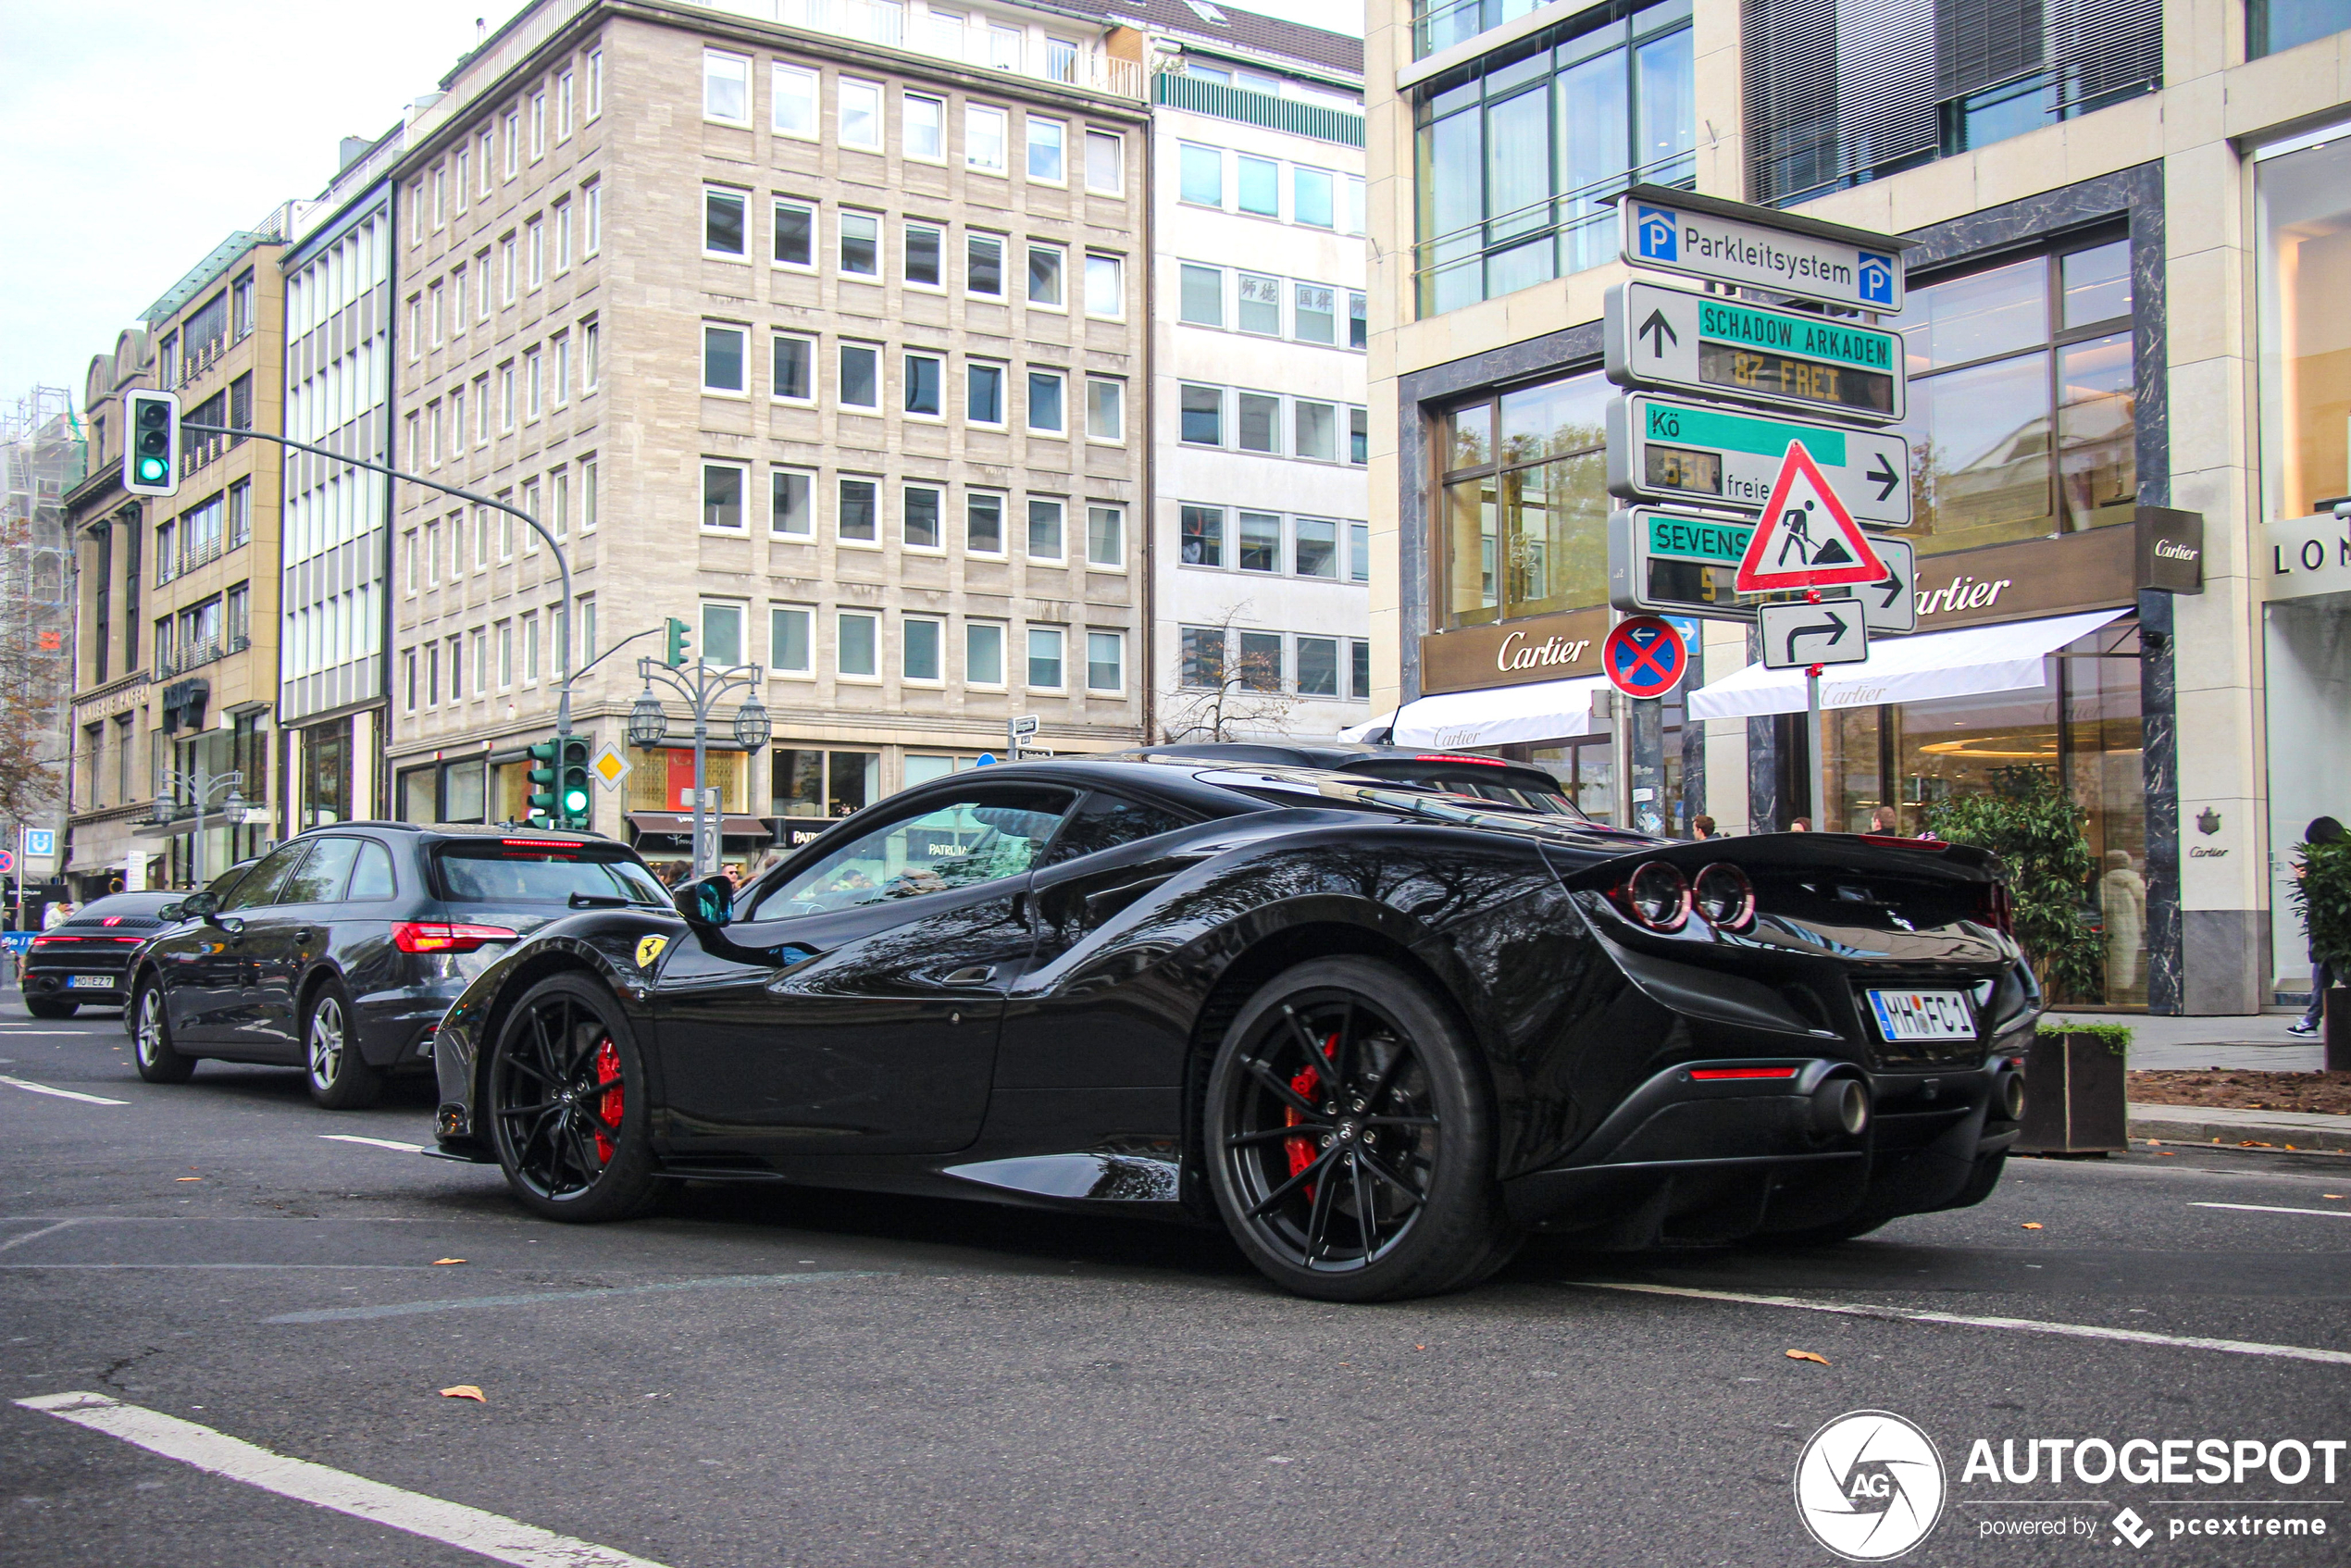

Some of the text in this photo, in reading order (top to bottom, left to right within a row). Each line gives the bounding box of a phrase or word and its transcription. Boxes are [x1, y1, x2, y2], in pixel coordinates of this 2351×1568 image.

[1686, 227, 1851, 285] Parkleitsystem
[1705, 306, 1886, 366] SCHADOW ARKADEN
[1735, 353, 1840, 402] 87 FREI
[1652, 410, 1680, 438] Kö
[1727, 474, 1770, 501] freie
[1655, 524, 1748, 557] SEVENS
[2154, 538, 2198, 561] Cartier
[1701, 567, 1717, 602] 5
[1914, 572, 2011, 616] artier
[1497, 630, 1590, 672] Cartier
[1821, 681, 1887, 706] Cartier
[1434, 726, 1481, 747] Cartier
[2189, 846, 2229, 858] Cartier
[1883, 996, 1920, 1033] MH
